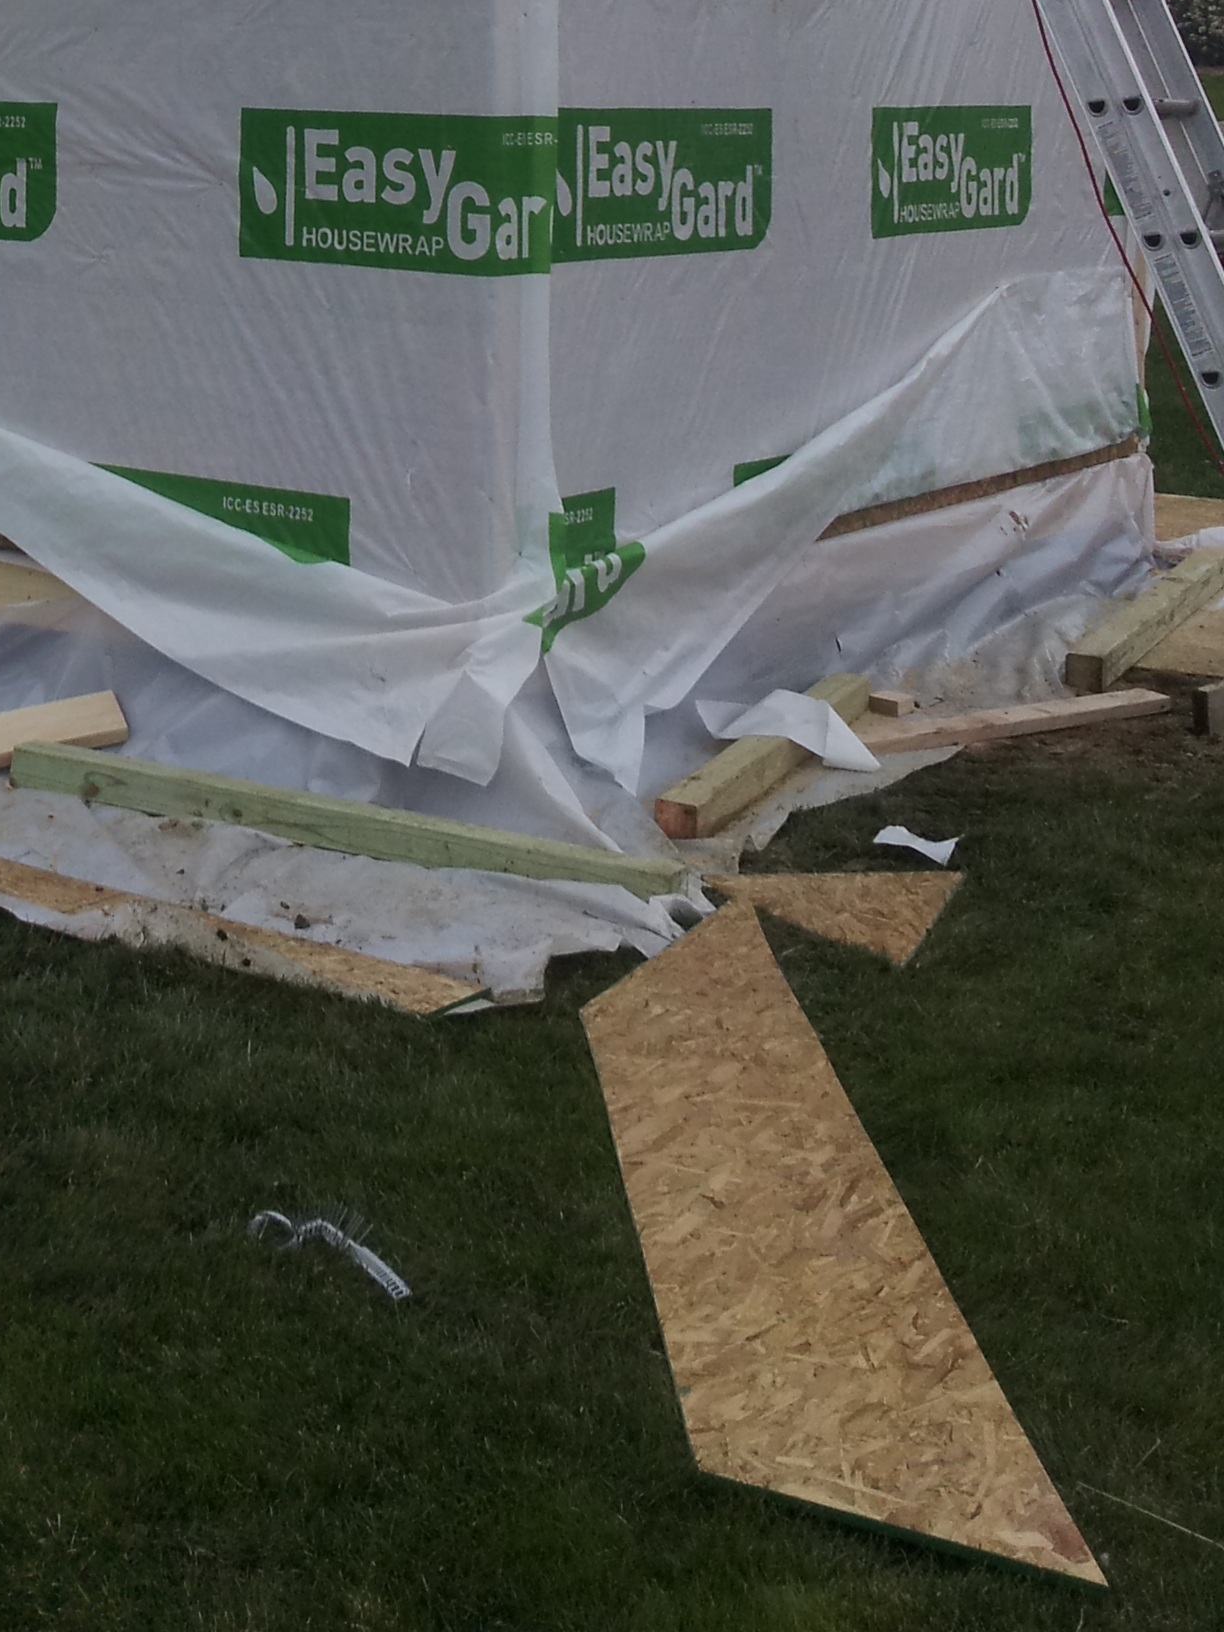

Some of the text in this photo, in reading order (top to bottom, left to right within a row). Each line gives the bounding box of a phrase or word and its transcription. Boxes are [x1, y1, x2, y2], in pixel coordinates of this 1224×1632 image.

[447, 181, 553, 261] Gar
[587, 223, 671, 246] HOUSEWRAP
[302, 227, 444, 256] HOUSEWRAP
